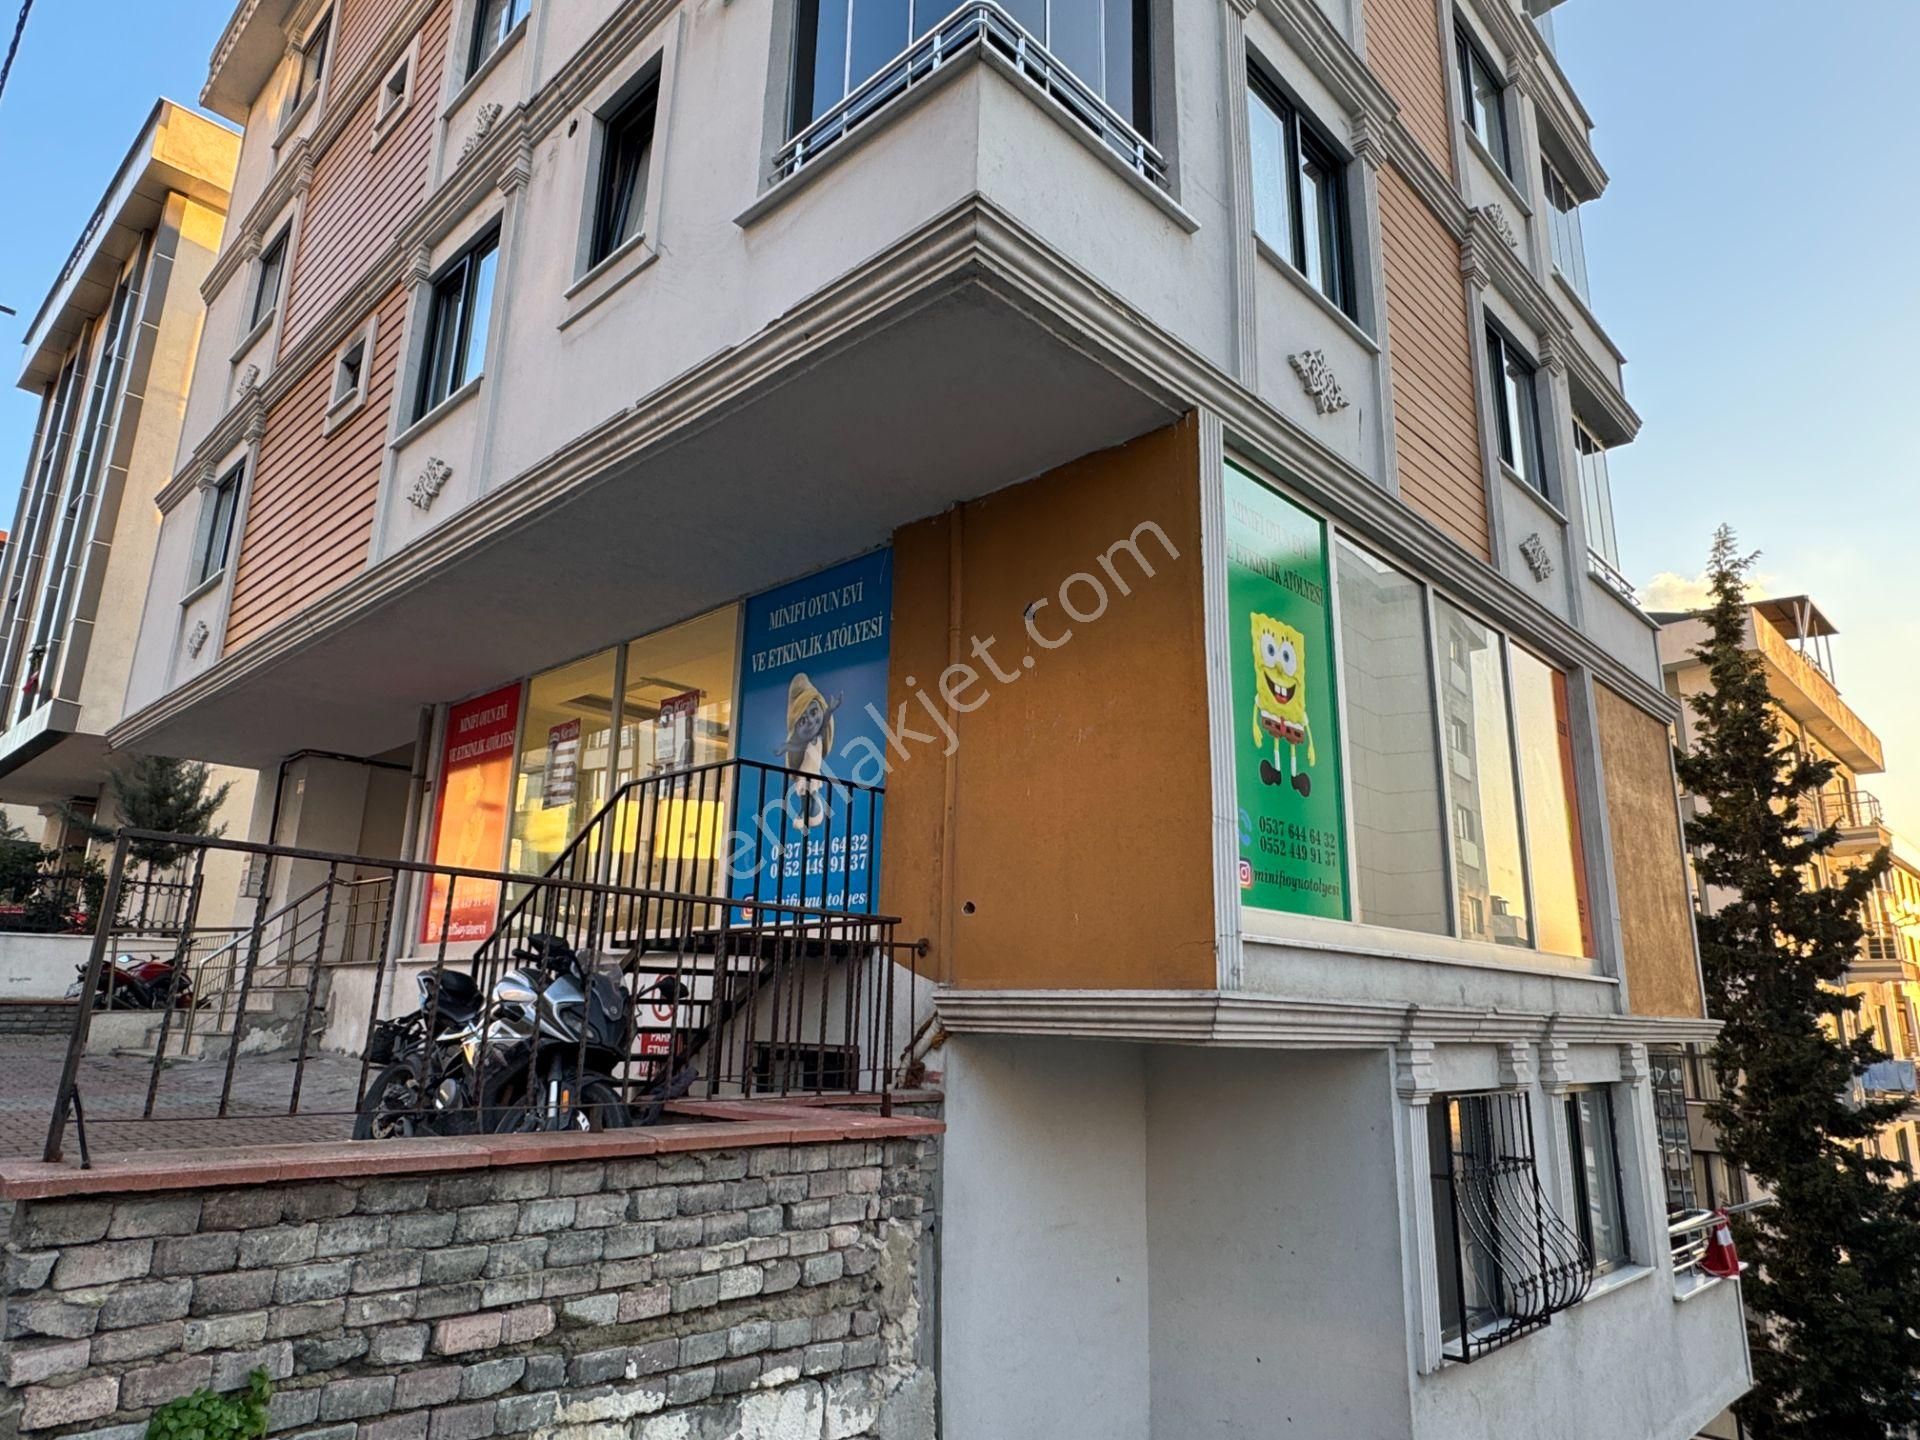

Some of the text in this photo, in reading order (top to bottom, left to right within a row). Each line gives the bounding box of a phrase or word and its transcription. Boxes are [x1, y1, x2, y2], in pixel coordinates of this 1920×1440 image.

[807, 589, 841, 618] OYUN
[841, 577, 863, 607] EVİ
[752, 651, 766, 673] VE
[767, 632, 822, 669] ETKİNLİK
[771, 842, 801, 861] 037
[831, 836, 846, 854] 64
[851, 833, 868, 851] 32
[1259, 816, 1335, 849] 0537 644 64 32
[770, 860, 800, 879] 052
[830, 856, 845, 873] 91
[850, 853, 867, 871] 37
[1260, 835, 1336, 868] 0552 449 91 37
